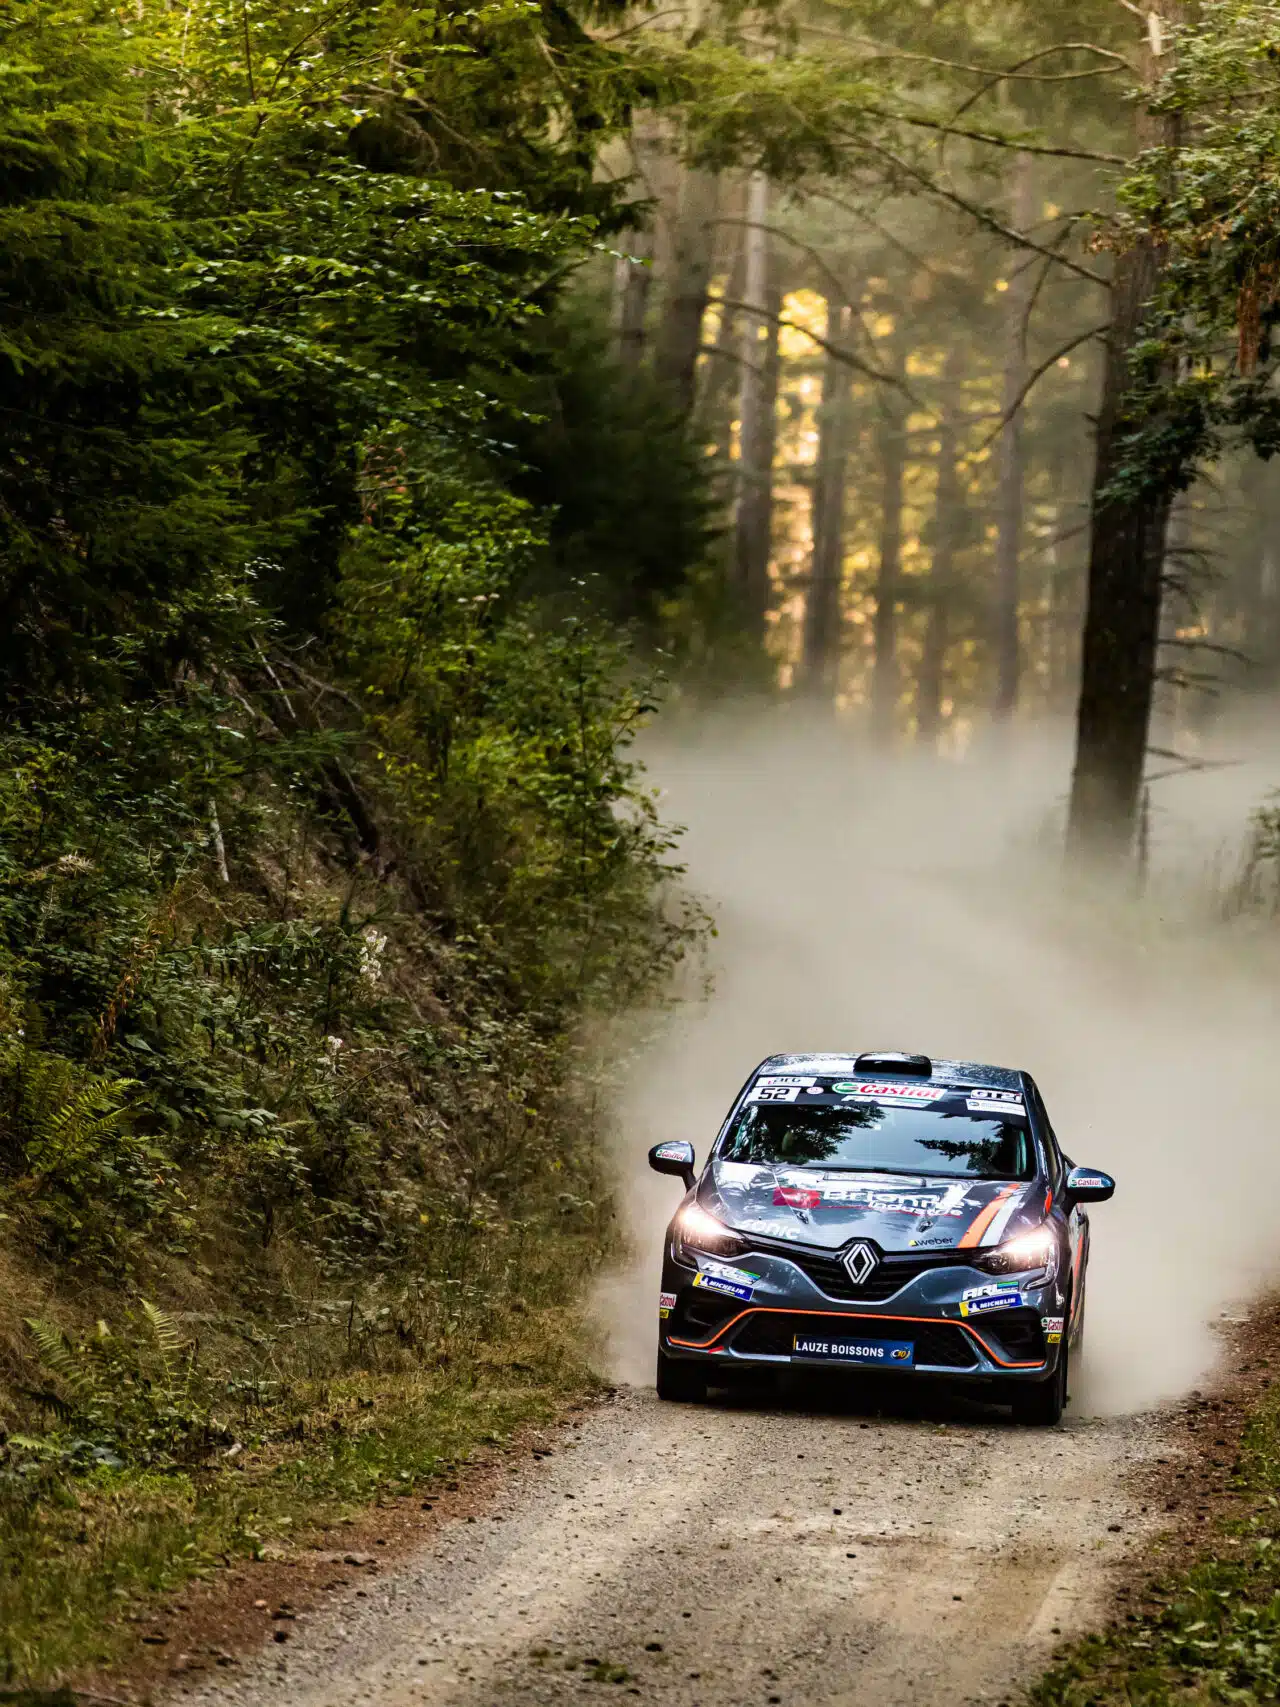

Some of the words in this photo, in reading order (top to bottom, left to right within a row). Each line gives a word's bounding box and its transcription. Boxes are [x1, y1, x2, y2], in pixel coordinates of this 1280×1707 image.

[758, 1087, 790, 1100] 52
[860, 1084, 940, 1098] Castrol
[918, 1237, 953, 1246] weber
[709, 1280, 746, 1295] MICHELIN
[979, 1297, 1016, 1309] MICHELIN
[796, 1341, 829, 1353] LAUZE
[831, 1344, 885, 1358] BOISSONS
